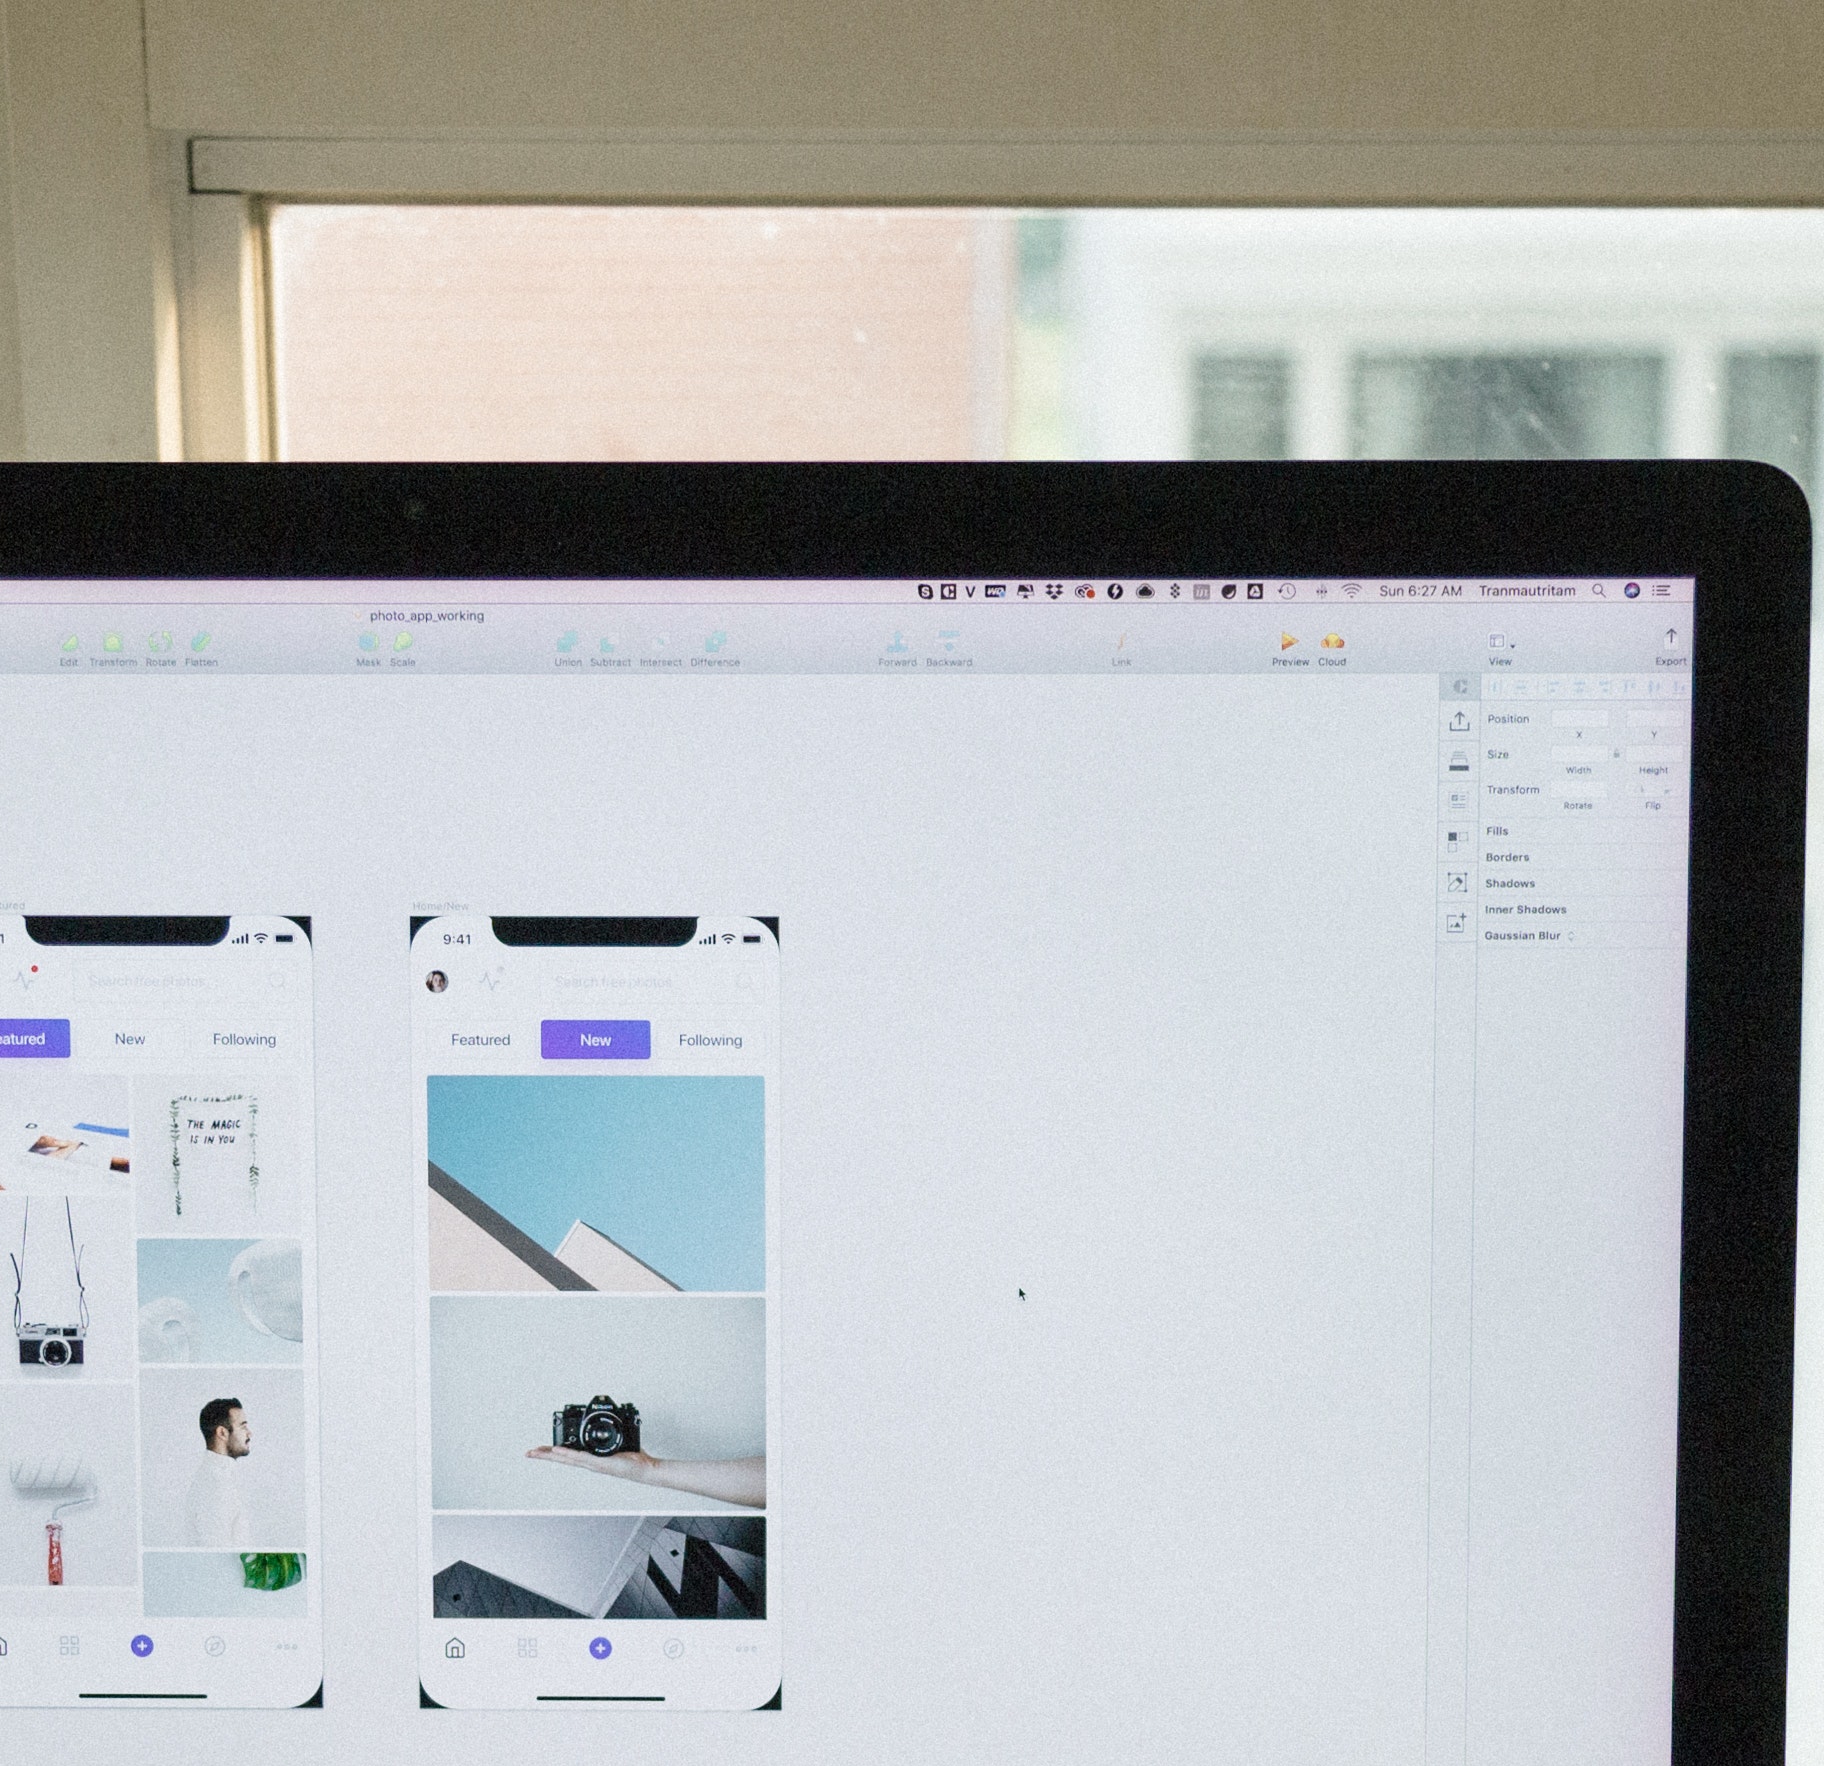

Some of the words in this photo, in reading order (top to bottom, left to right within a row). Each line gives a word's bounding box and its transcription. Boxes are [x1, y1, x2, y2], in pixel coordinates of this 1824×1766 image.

[1380, 585, 1404, 596] Sun
[1408, 584, 1440, 597] 6:27
[1442, 586, 1462, 596] AM
[1480, 586, 1575, 596] Tranmautritam
[370, 610, 484, 623] photo_app_working
[60, 658, 78, 667] Edit
[90, 658, 137, 667] Transform
[146, 658, 176, 667] Rotate
[185, 658, 218, 667] Flatten
[357, 658, 381, 667] Mask
[390, 658, 415, 667] Scale
[555, 658, 582, 667] Union
[590, 658, 631, 667] Subtract
[640, 658, 682, 667] Intersect
[691, 658, 740, 667] Difference
[879, 658, 917, 667] Forward
[926, 658, 973, 667] Backward
[1272, 657, 1309, 666] Preview
[1318, 657, 1346, 666] Cloud
[1489, 657, 1512, 666] View
[1656, 657, 1687, 667] Export
[1488, 714, 1529, 723] Position
[1488, 750, 1509, 759] Size
[1640, 767, 1668, 775] Height
[1488, 785, 1539, 794] Transform
[1645, 802, 1661, 810] Flip
[1487, 827, 1508, 836] Fills
[1486, 853, 1529, 862] Borders
[1486, 879, 1535, 888] Shadows
[413, 901, 470, 911] Home/New
[1486, 906, 1513, 914] Inner
[1517, 905, 1566, 914] Shadows
[443, 933, 471, 946] 9:41
[1485, 932, 1535, 940] Gaussian
[1539, 932, 1560, 940] Blur
[88, 974, 127, 987] Search
[130, 974, 156, 987] free
[161, 974, 206, 990] photos
[554, 975, 594, 988] Search
[597, 975, 623, 988] free
[626, 975, 673, 991] photos
[115, 1032, 145, 1045] New
[213, 1032, 277, 1049] Following
[451, 1032, 511, 1047] Featured
[580, 1033, 611, 1047] New
[678, 1033, 742, 1050] Following
[187, 1119, 204, 1129] THE
[211, 1120, 242, 1130] MAGIC
[189, 1136, 198, 1144] IS
[205, 1136, 215, 1144] IN
[219, 1135, 235, 1144] YOU
